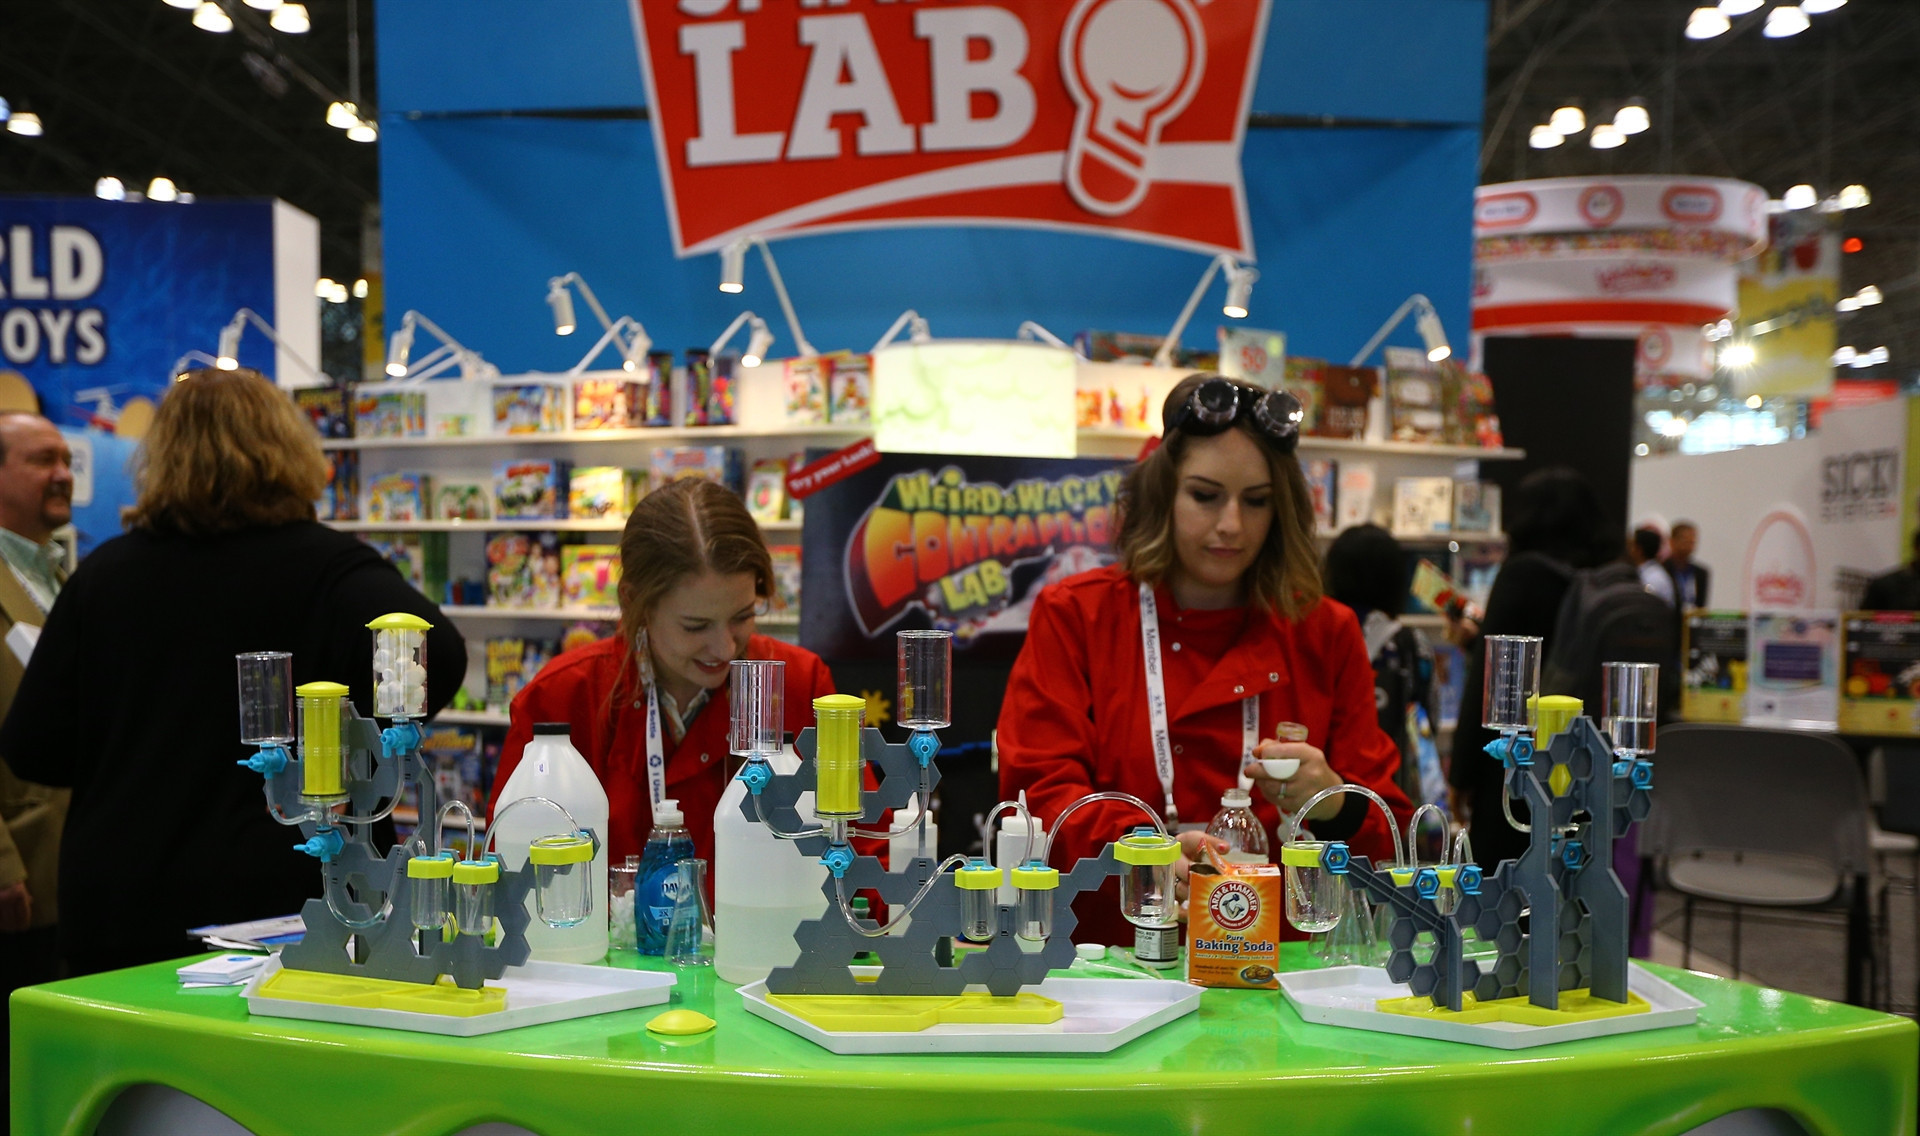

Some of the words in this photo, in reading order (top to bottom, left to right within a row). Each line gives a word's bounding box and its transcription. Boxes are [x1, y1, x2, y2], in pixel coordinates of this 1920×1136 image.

[679, 5, 1037, 167] LAB
[0, 225, 103, 300] LD
[1017, 473, 1122, 511] WACKY
[939, 560, 1007, 611] LAB
[1146, 628, 1157, 675] Member
[1155, 729, 1169, 779] Member
[1211, 889, 1223, 910] ARM
[1229, 883, 1258, 911] HAMMER
[1196, 938, 1240, 954] Baking
[1243, 940, 1274, 952] Soda
